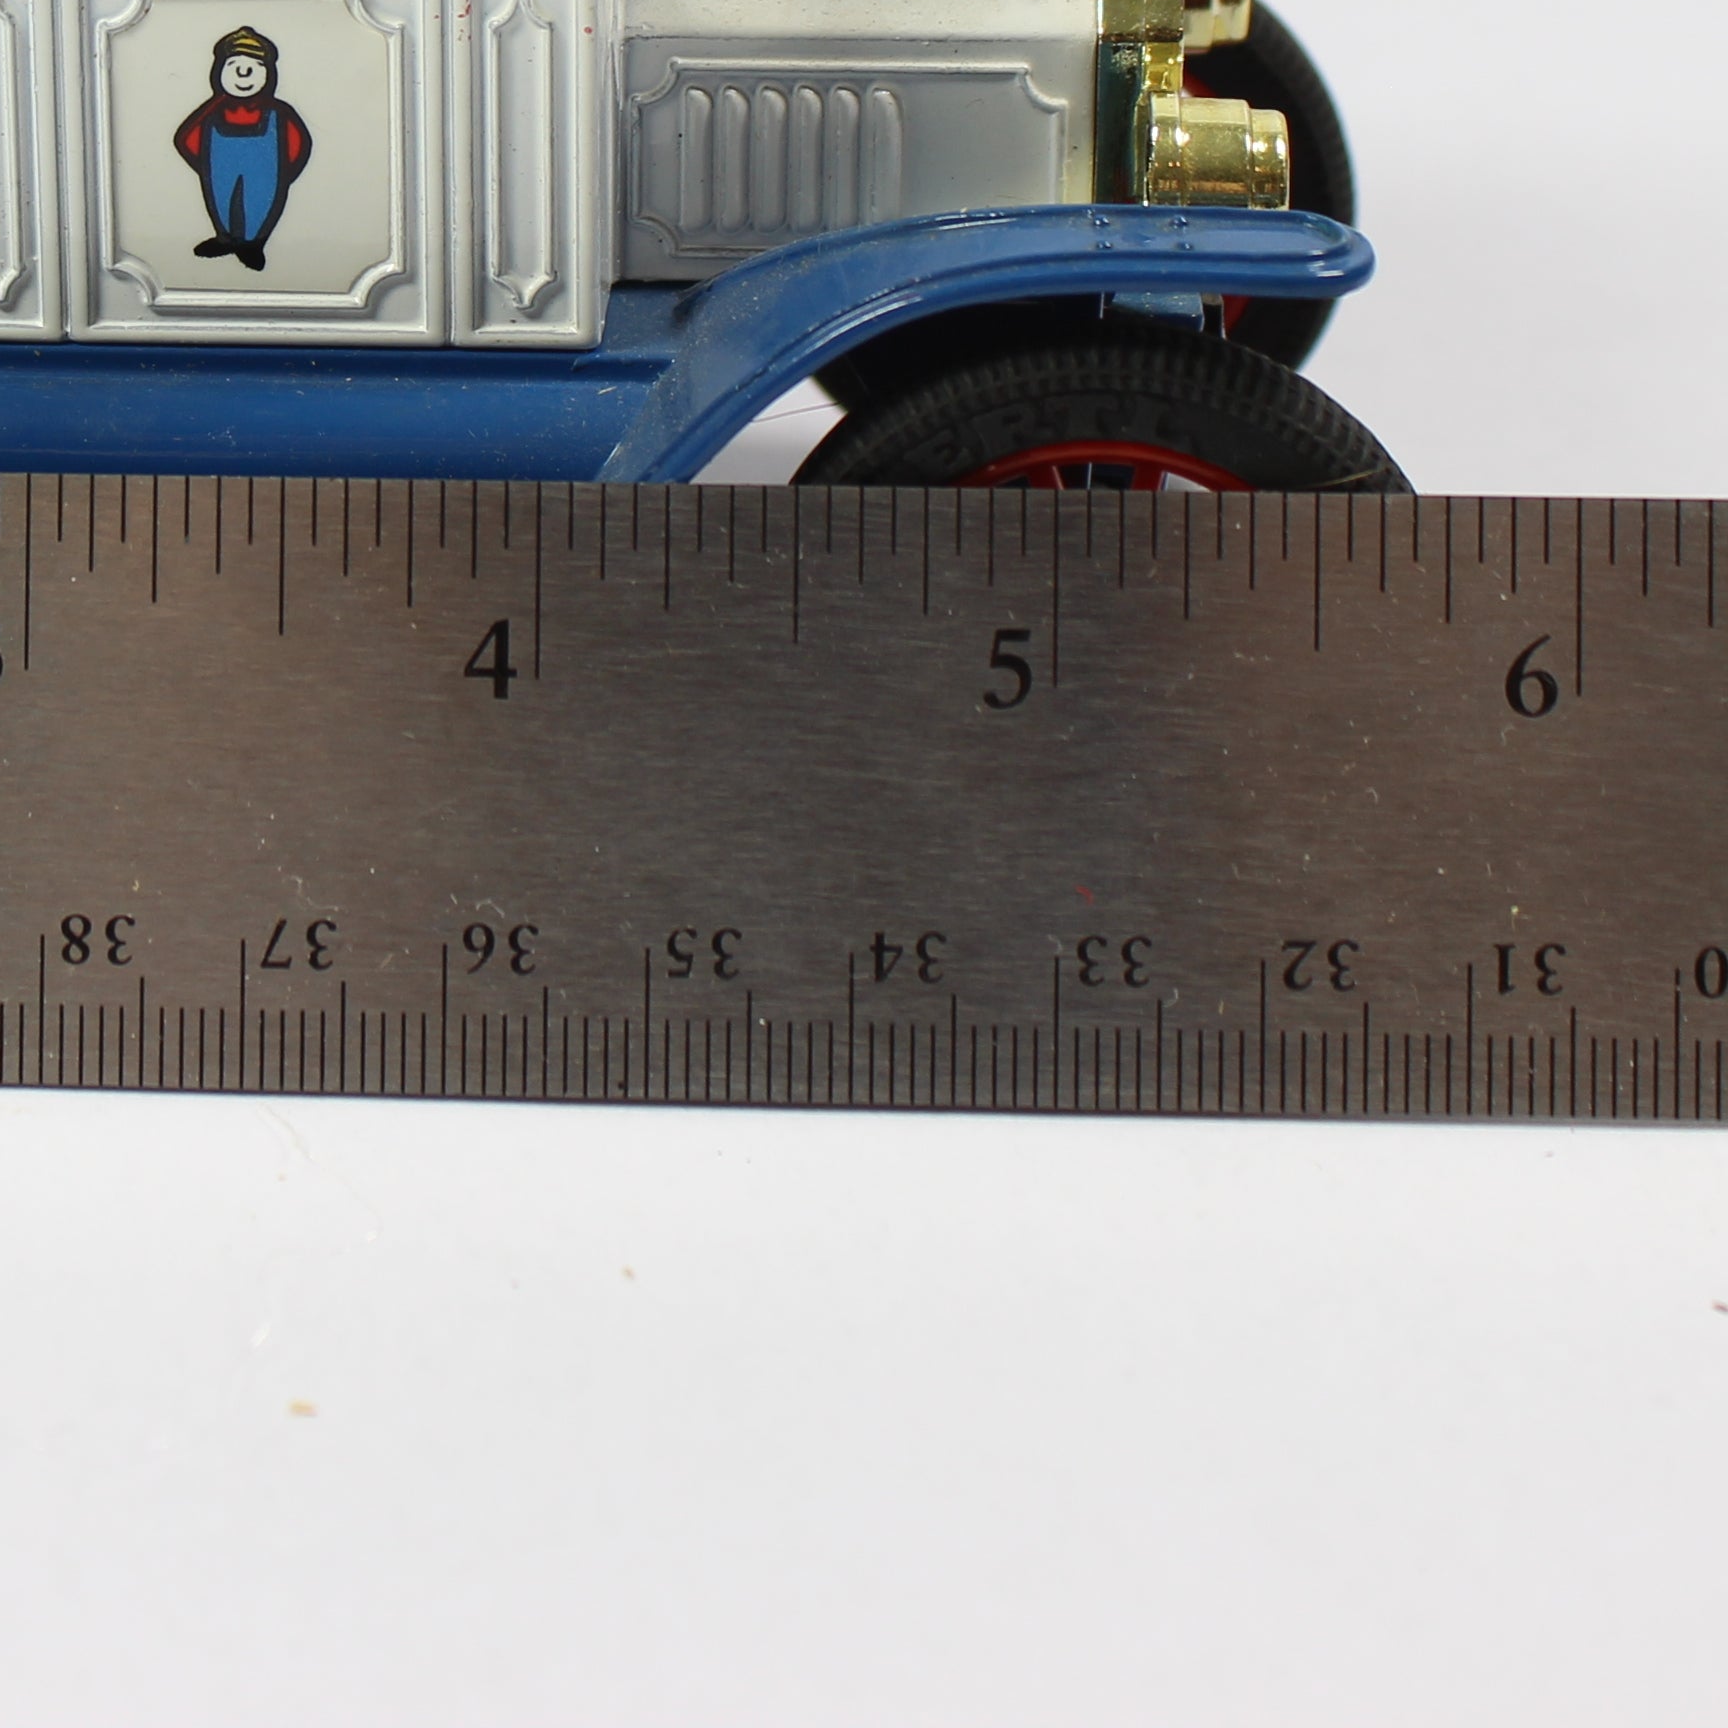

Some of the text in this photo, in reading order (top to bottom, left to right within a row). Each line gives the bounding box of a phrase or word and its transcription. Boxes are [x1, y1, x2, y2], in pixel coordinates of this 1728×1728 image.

[462, 617, 518, 701] 4
[982, 628, 1033, 710] 5
[1504, 633, 1559, 718] 6
[59, 914, 136, 966] 38
[259, 918, 338, 971] 37
[462, 922, 540, 977] 36
[665, 927, 744, 982] 35
[868, 929, 949, 986] 34
[1075, 933, 1154, 989] 33
[1280, 938, 1360, 993] 32
[1493, 942, 1567, 997] 31
